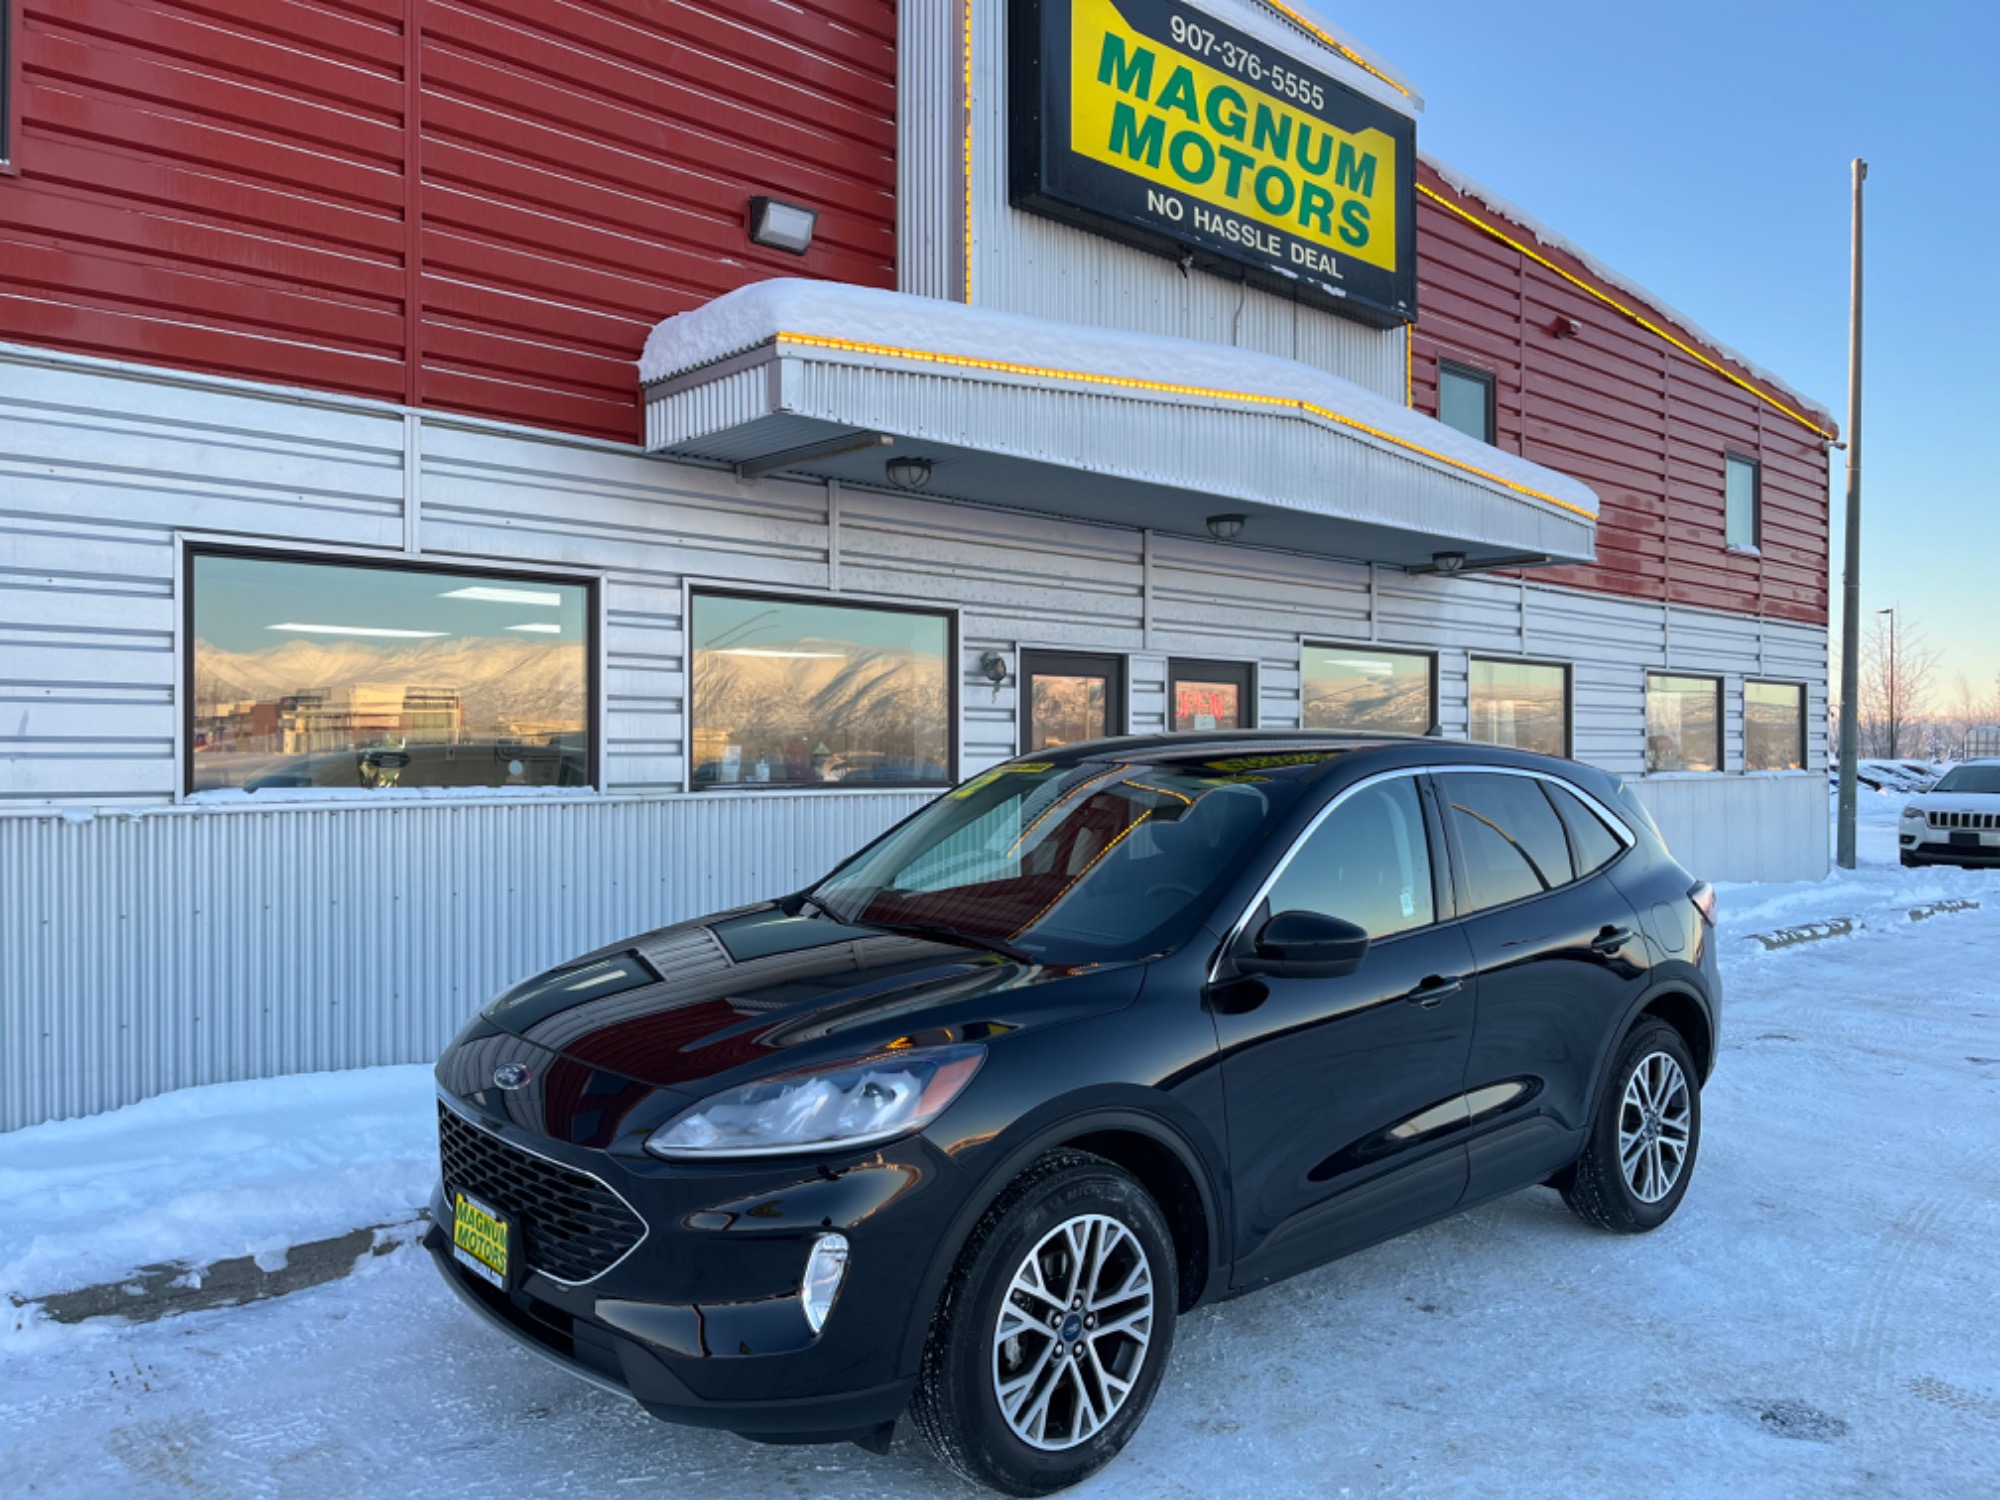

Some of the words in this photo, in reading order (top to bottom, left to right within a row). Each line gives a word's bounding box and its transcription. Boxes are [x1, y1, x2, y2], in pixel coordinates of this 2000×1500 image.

[1170, 14, 1325, 111] 907-376-5555
[1097, 30, 1378, 198] MAGNUM
[1108, 100, 1370, 247] MOTORS
[1147, 188, 1183, 221] NO
[1193, 206, 1281, 257] HASSLE
[1290, 243, 1344, 280] DEAL
[457, 1202, 508, 1249] MAGNUM
[457, 1224, 507, 1271] MOTORS
